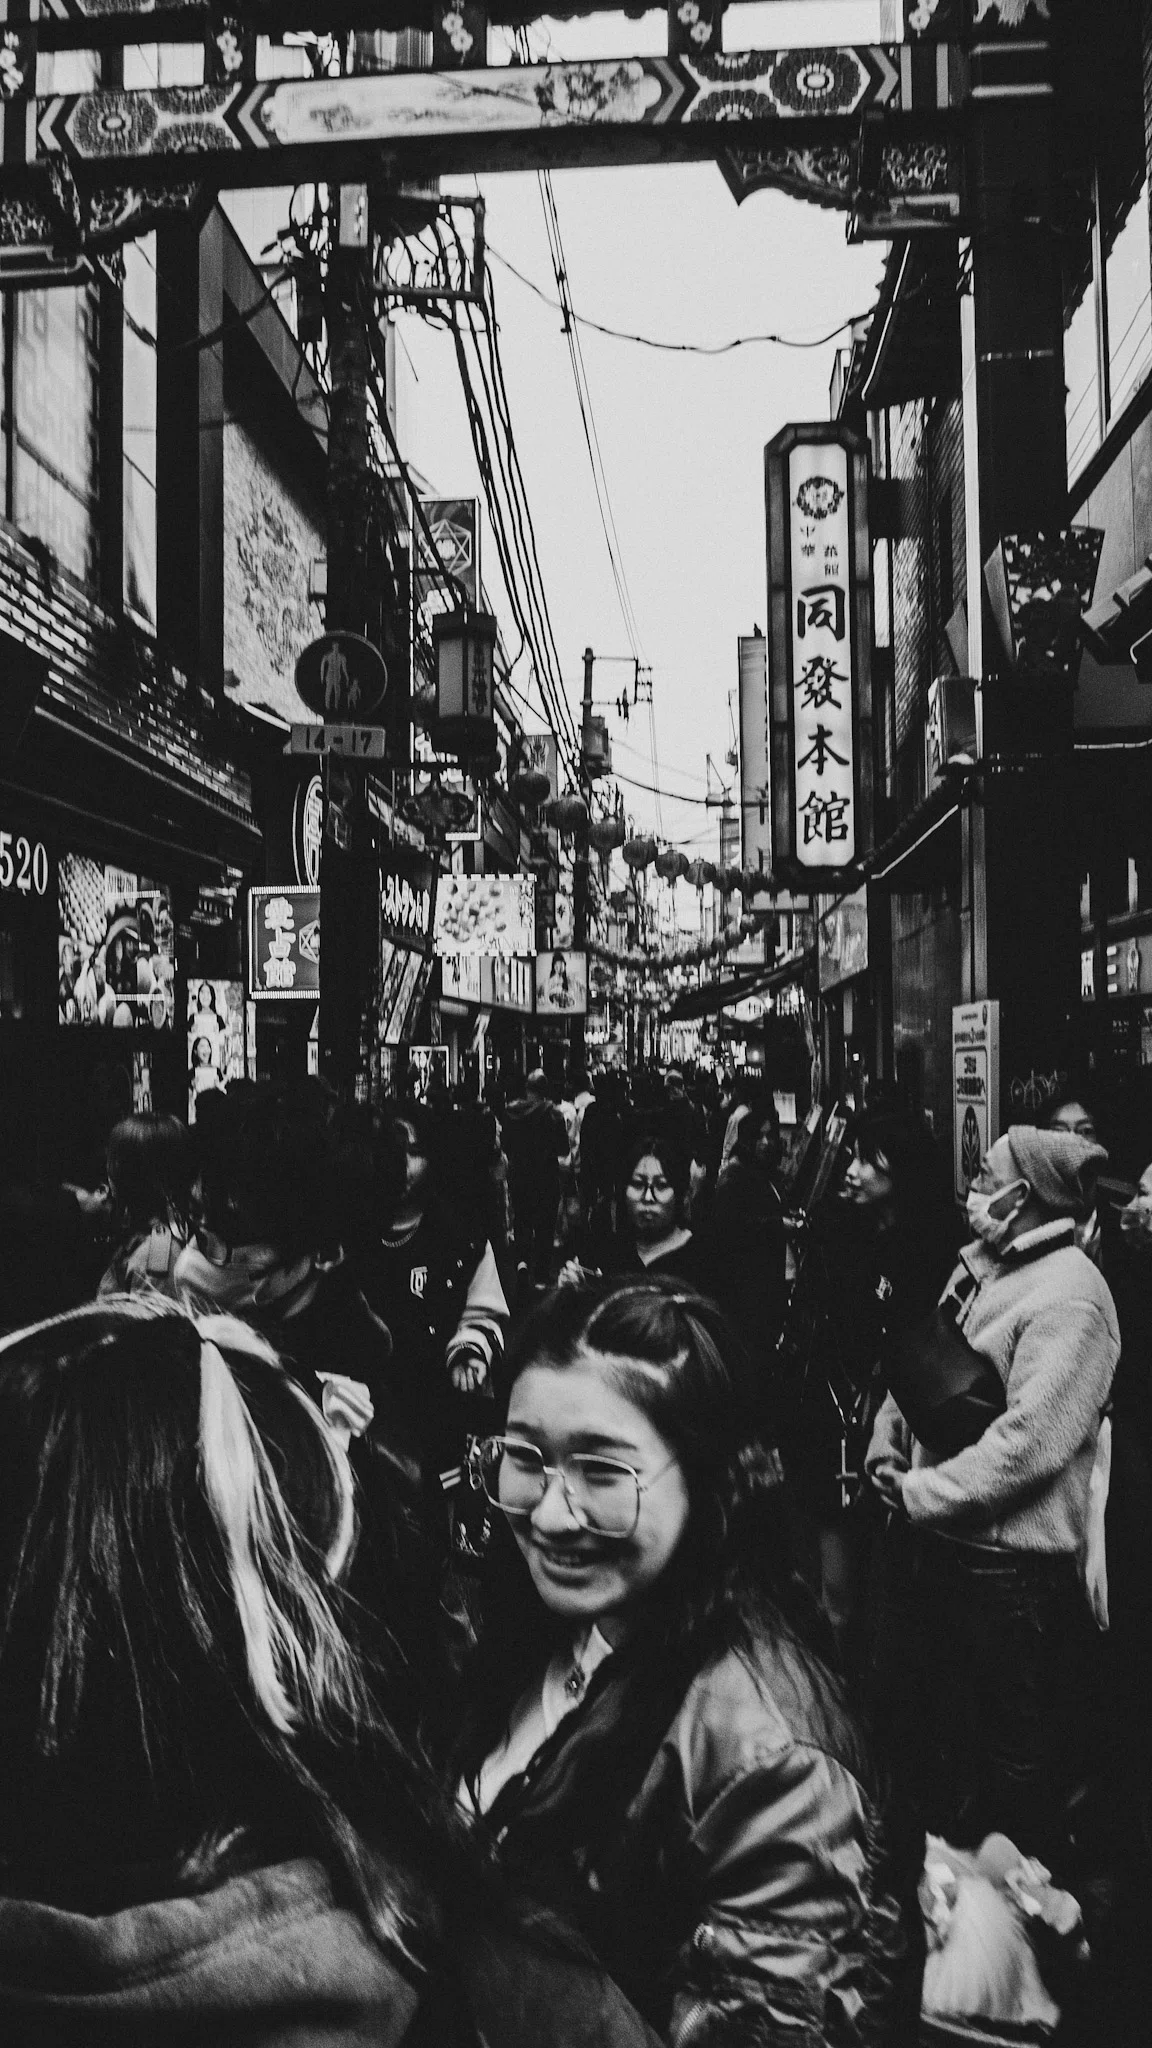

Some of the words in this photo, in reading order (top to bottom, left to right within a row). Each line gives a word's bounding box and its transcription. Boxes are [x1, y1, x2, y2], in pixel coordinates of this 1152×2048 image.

[306, 726, 372, 754] 14-17
[795, 584, 850, 845] 同發本館
[0, 830, 48, 896] 520
